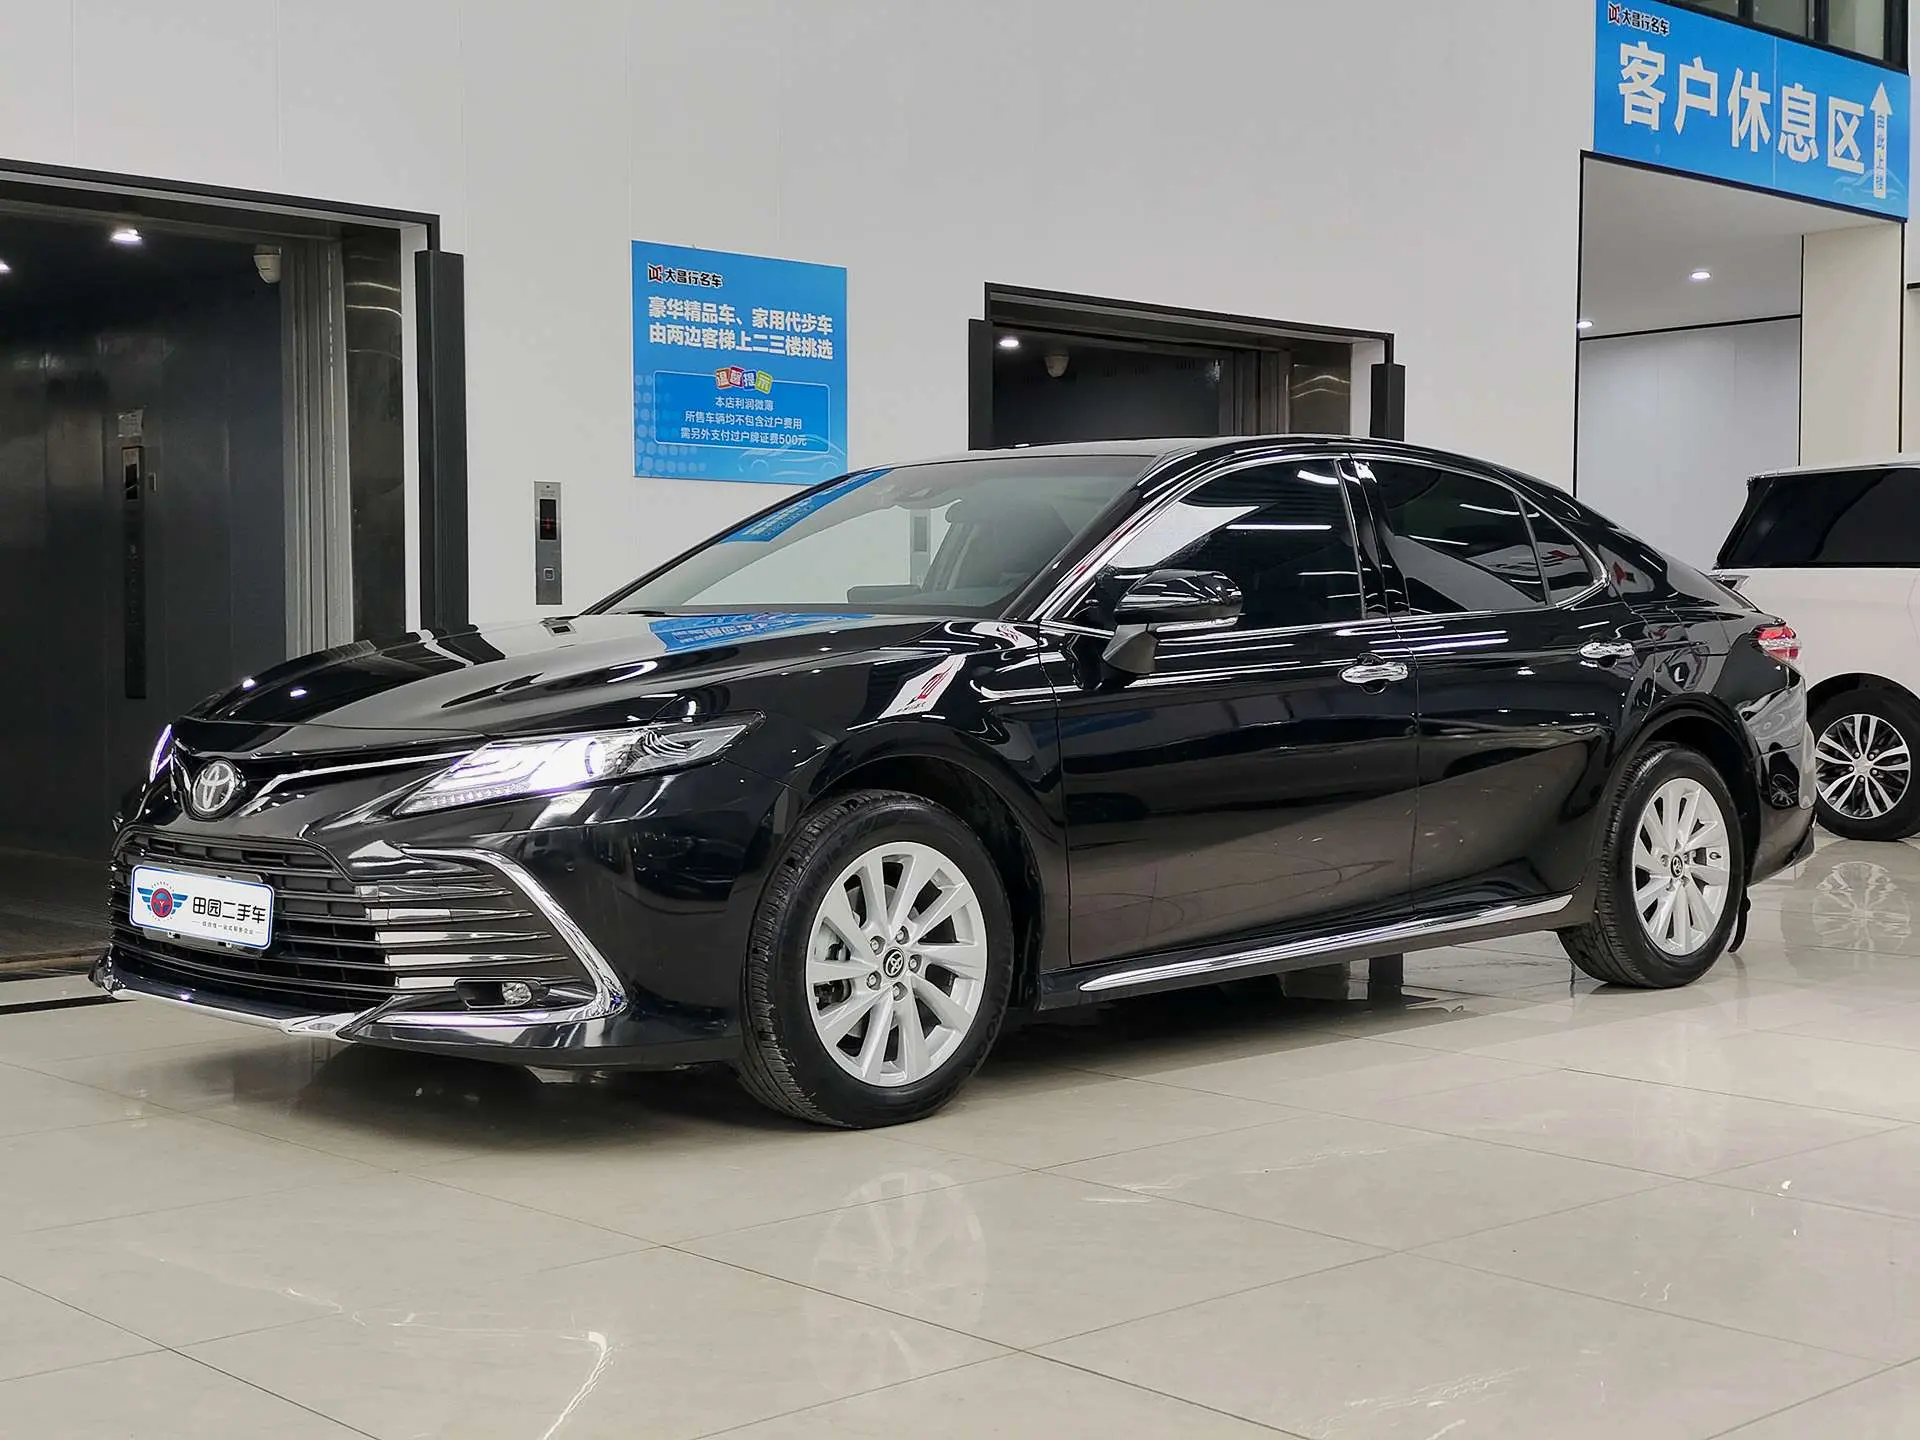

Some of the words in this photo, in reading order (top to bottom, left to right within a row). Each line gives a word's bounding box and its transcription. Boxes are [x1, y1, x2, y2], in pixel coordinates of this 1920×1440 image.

[1622, 9, 1670, 36] 大昌行名车
[1618, 41, 1865, 174] 客户休息区
[665, 268, 722, 288] 大昌行名车
[649, 322, 833, 360] 由两边客梯上二三楼挑选
[715, 396, 774, 412] 本店利润微薄
[685, 411, 803, 430] 所售车辆均不包含过户费用
[680, 427, 808, 447] 需另外支付过户牌证费500元
[192, 896, 267, 924] 田园二手车
